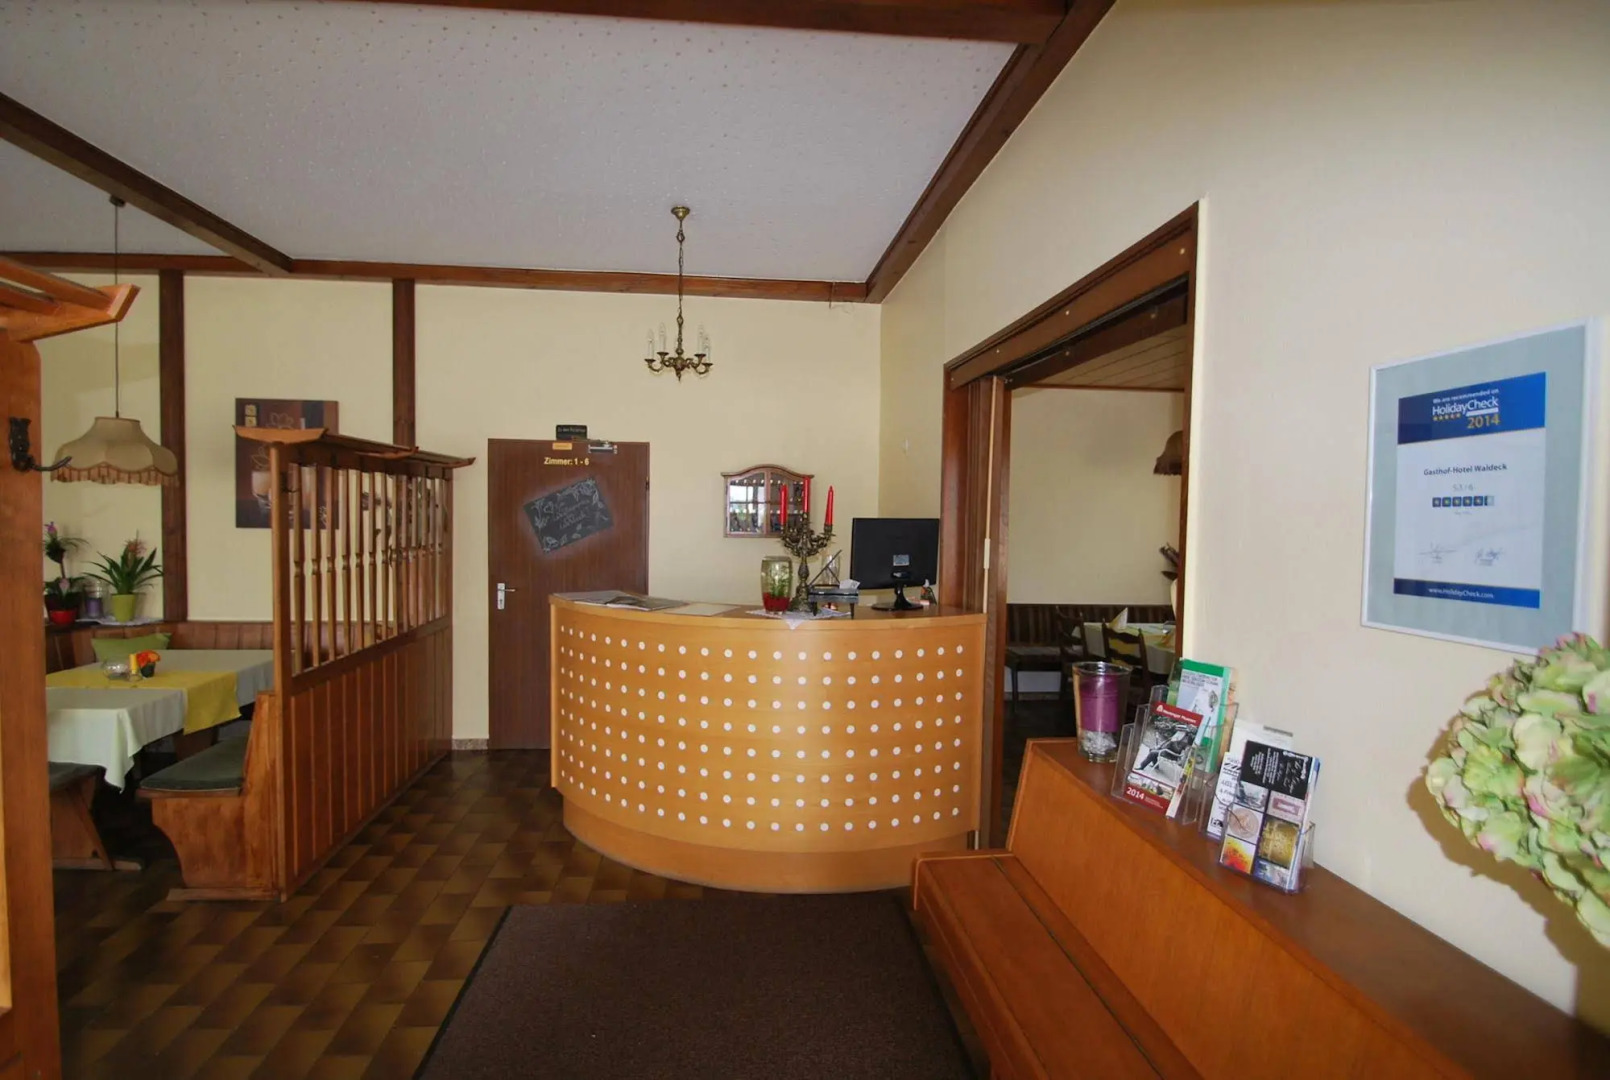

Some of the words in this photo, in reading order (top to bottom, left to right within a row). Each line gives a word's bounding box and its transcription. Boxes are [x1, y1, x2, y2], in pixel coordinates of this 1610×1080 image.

[1432, 395, 1499, 416] HolidayCheck
[1467, 413, 1501, 429] 2014
[543, 456, 573, 466] Zimmer:
[584, 457, 590, 466] 6
[1423, 465, 1472, 476] Gasthof-Hotel
[1474, 463, 1508, 473] Waldeck
[1428, 587, 1495, 599] www.HolidayCheck.com
[1126, 786, 1145, 800] 2014
